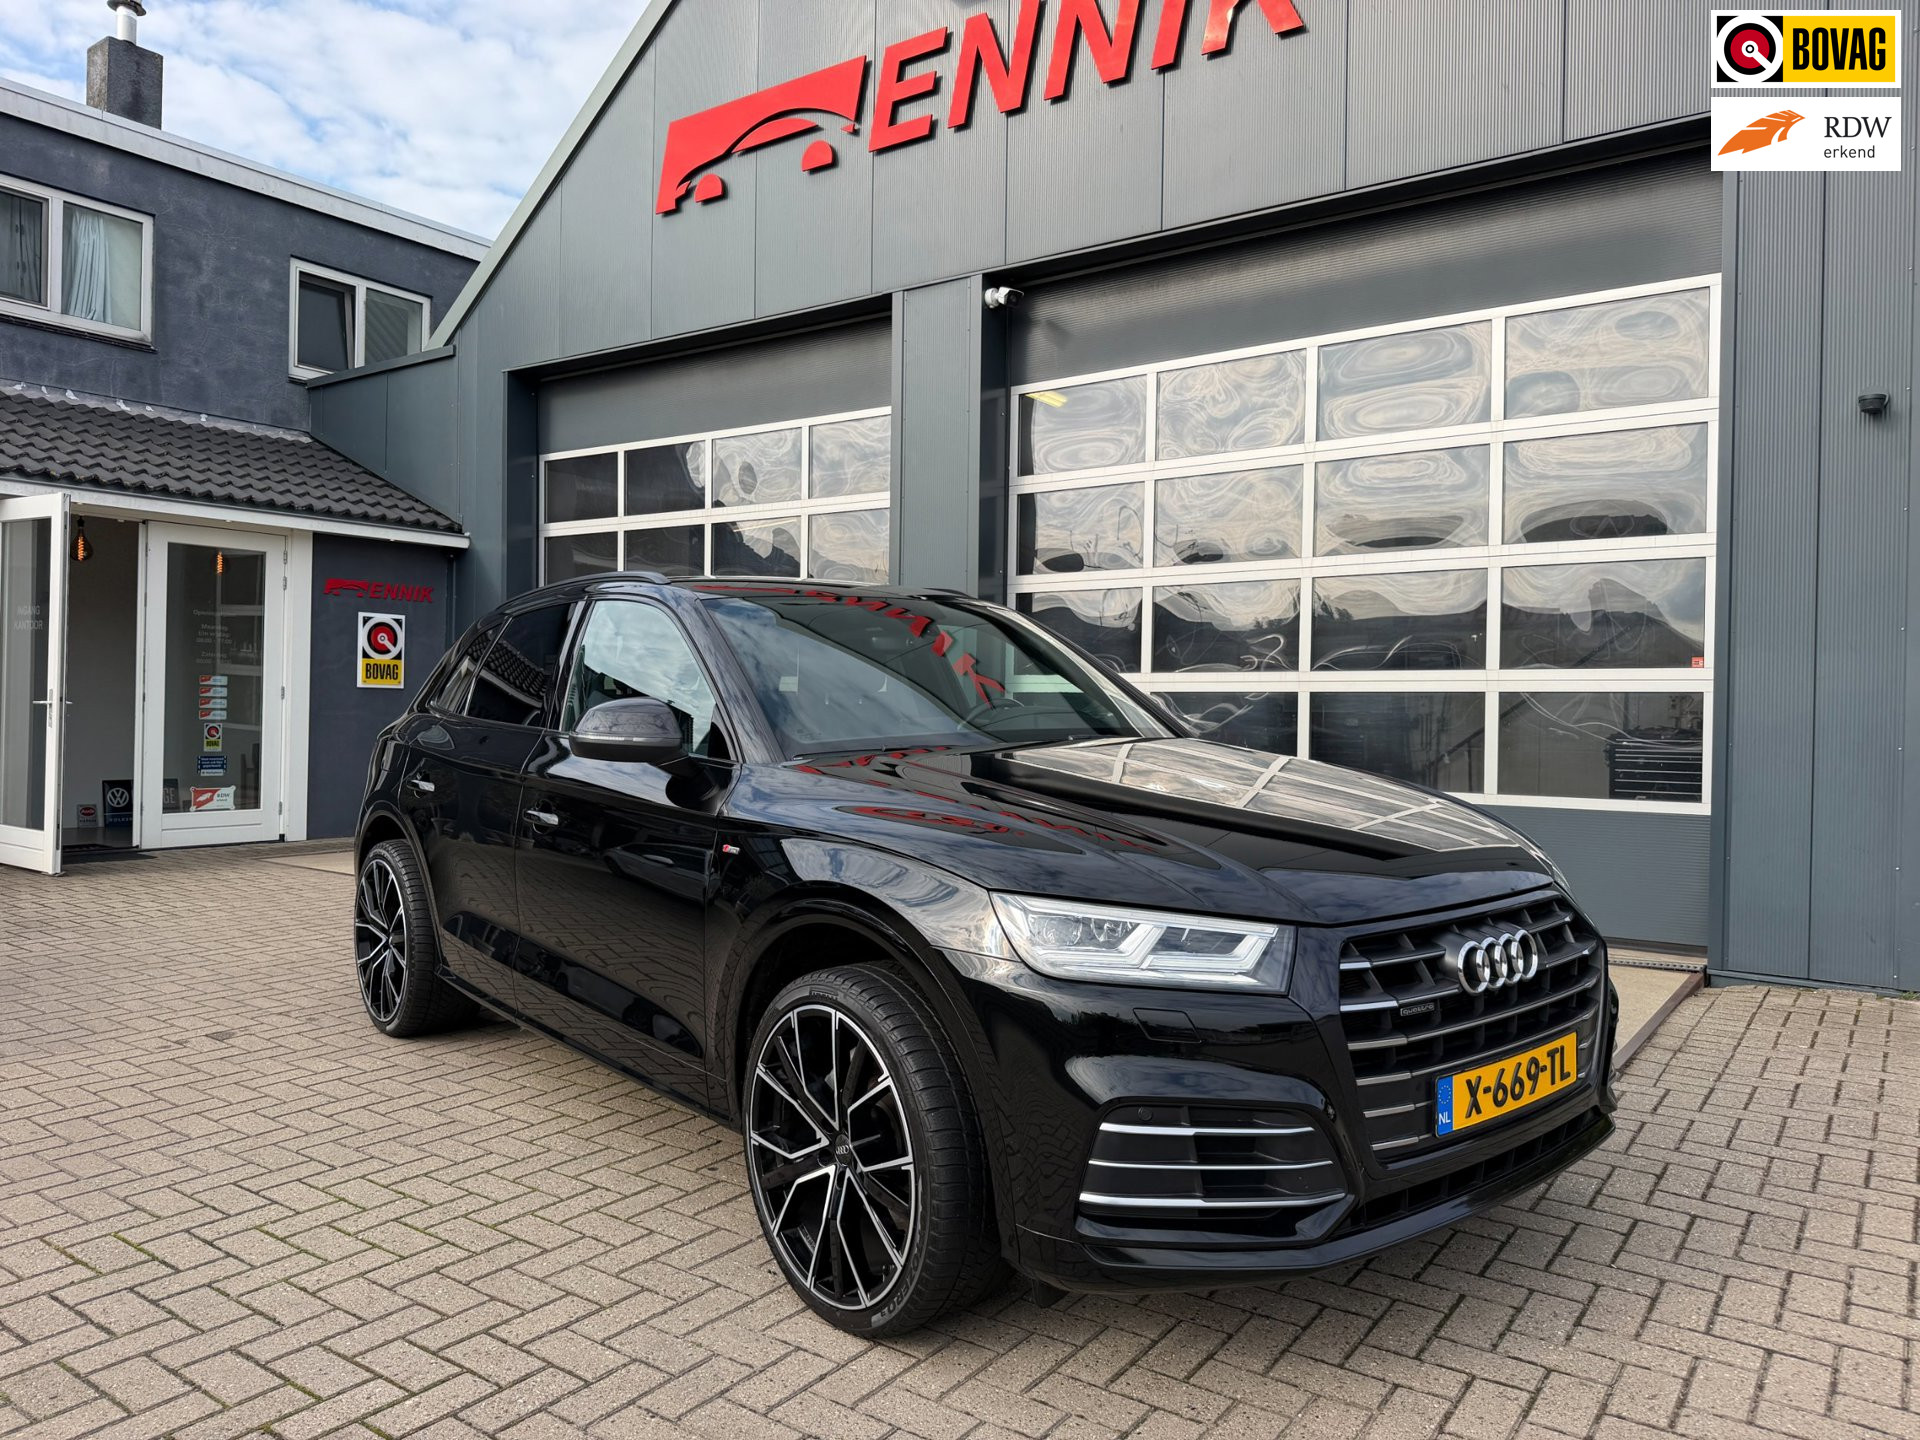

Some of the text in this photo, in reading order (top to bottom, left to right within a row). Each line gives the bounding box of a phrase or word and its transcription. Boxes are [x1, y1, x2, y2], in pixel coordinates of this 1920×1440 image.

[365, 662, 399, 681] BOVAG
[1465, 1045, 1571, 1119] X-669-TL
[1438, 1112, 1451, 1125] NL
